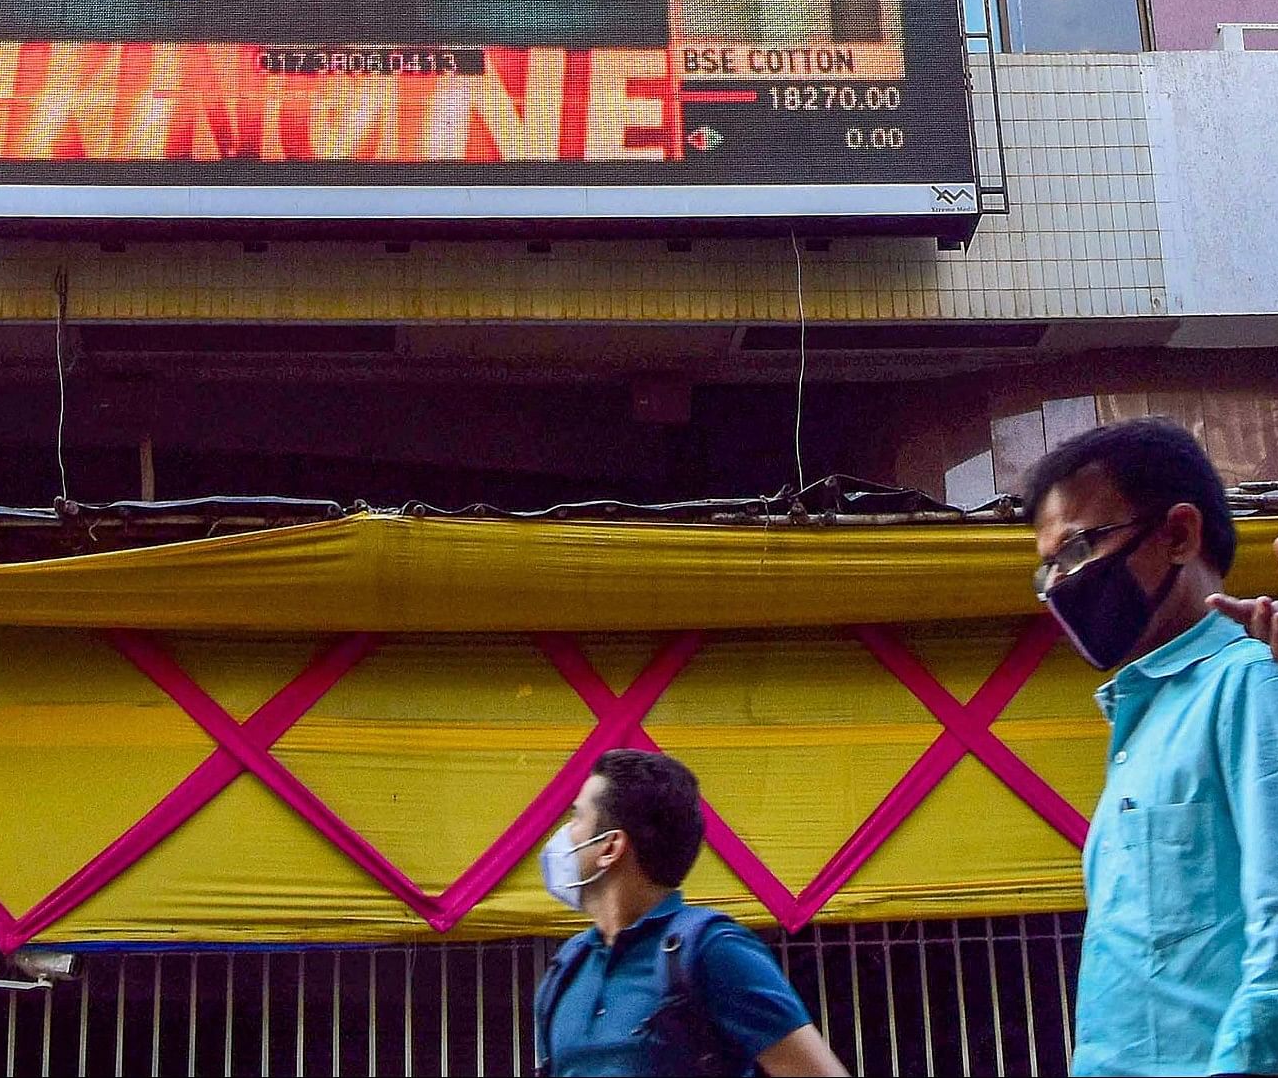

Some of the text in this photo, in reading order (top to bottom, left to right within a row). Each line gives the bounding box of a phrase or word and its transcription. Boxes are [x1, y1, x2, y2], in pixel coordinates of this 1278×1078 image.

[683, 48, 857, 73] BSE COTTON
[769, 86, 901, 111] 18270.00
[845, 127, 904, 150] 0.00
